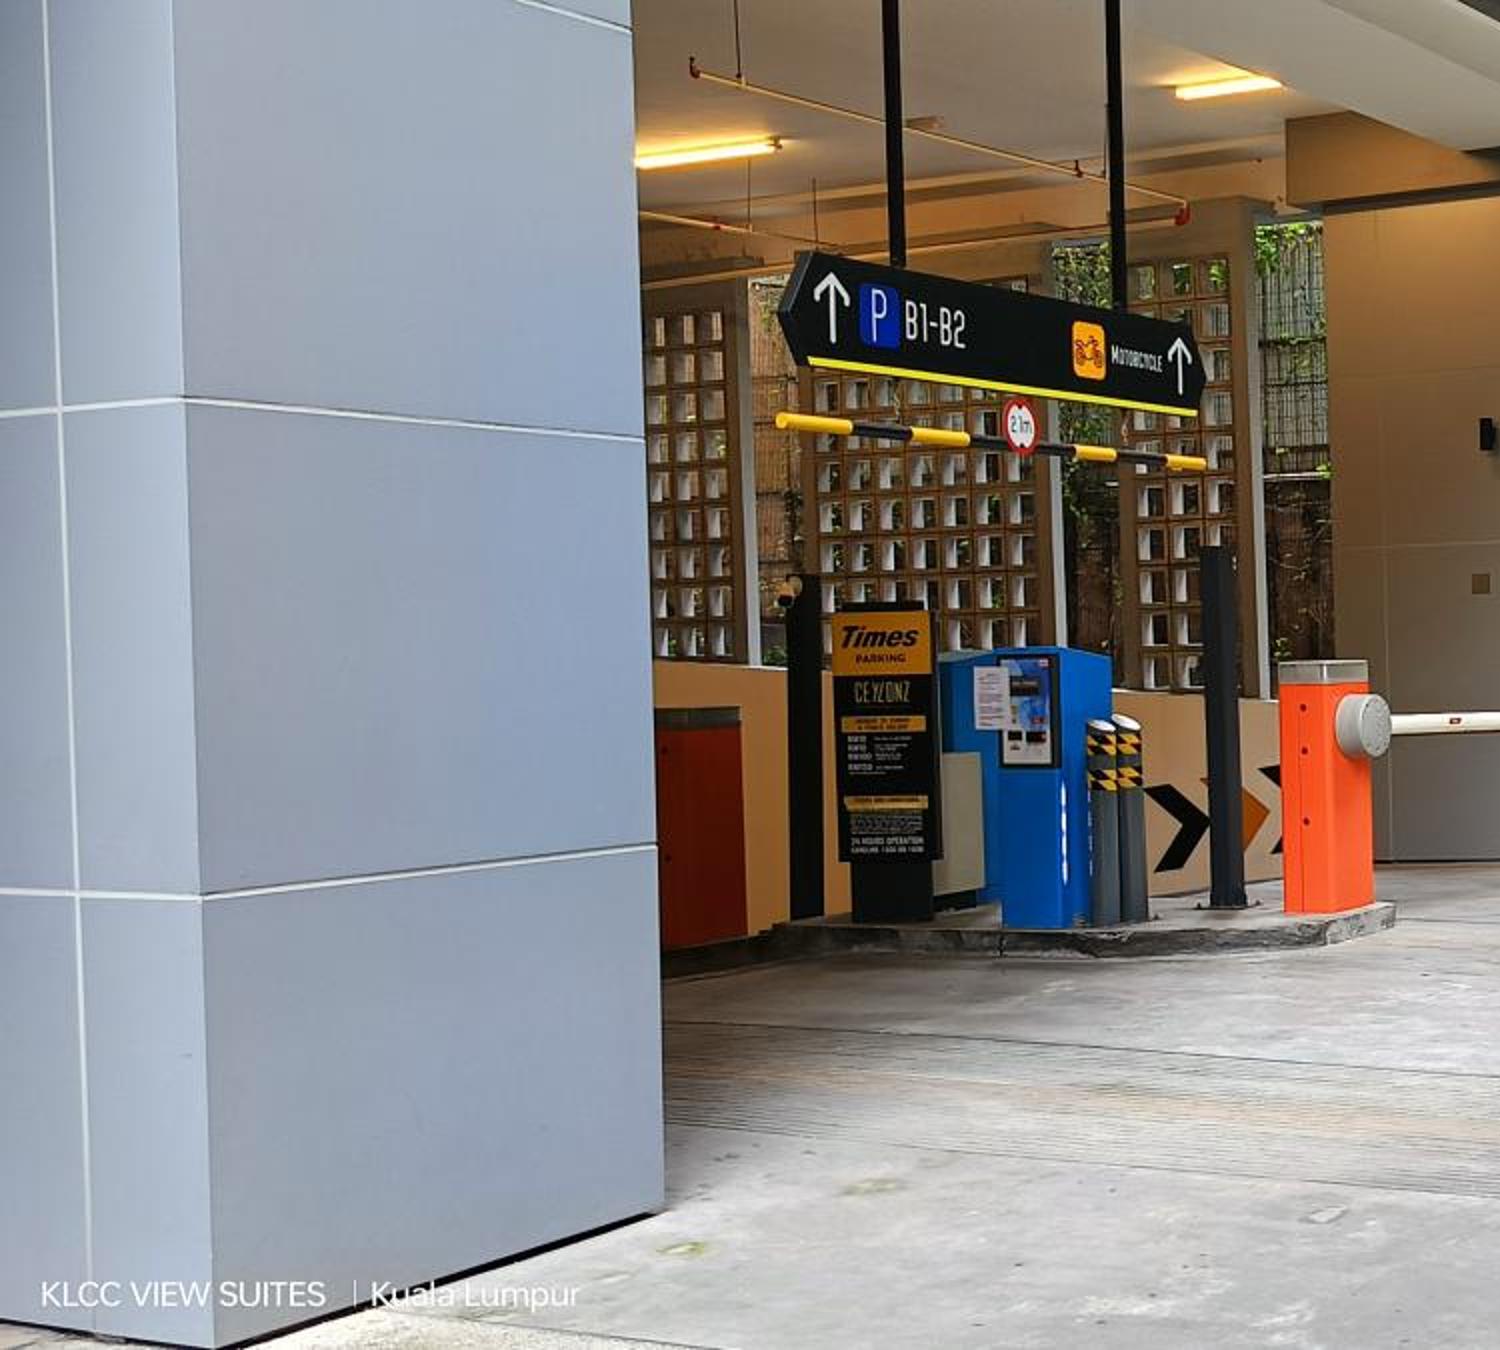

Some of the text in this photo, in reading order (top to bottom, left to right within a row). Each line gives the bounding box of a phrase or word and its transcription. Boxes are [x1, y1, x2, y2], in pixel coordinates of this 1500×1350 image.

[871, 288, 966, 350] P B1-B2
[841, 625, 919, 648] Times
[855, 653, 907, 664] PARKING
